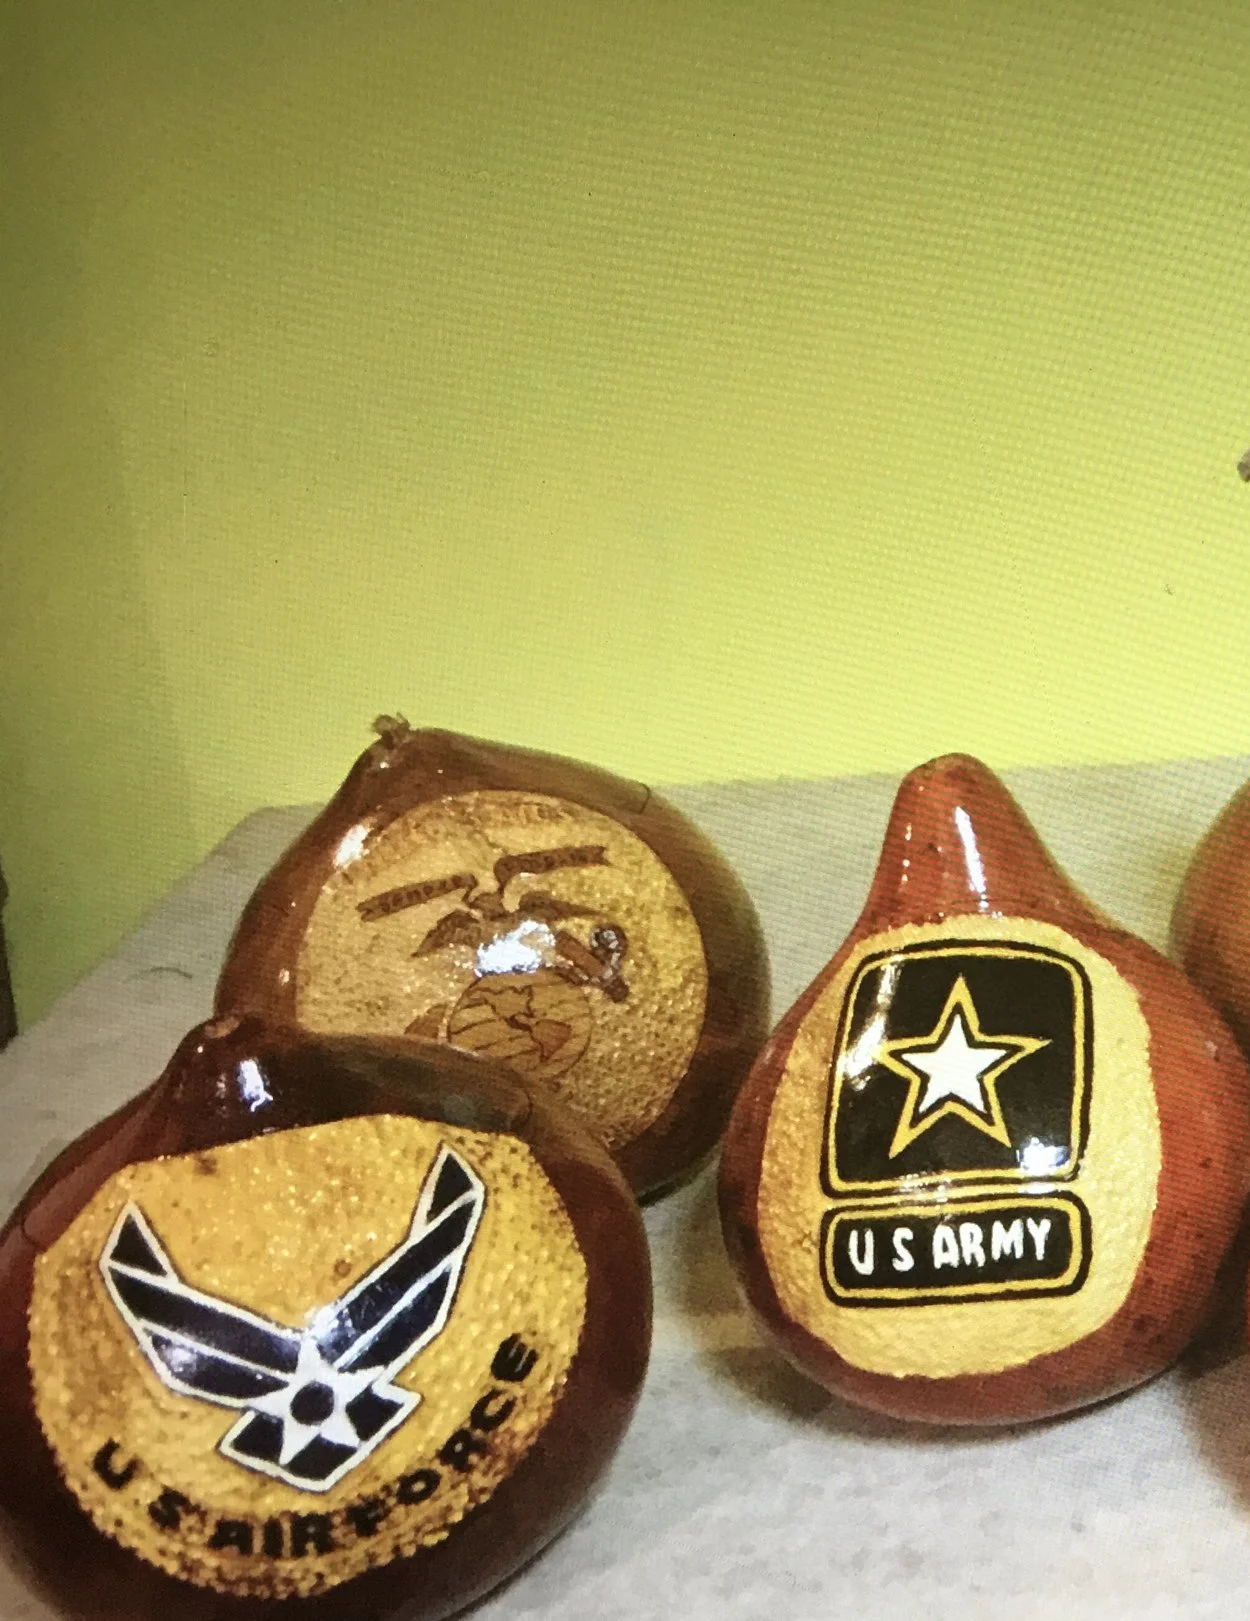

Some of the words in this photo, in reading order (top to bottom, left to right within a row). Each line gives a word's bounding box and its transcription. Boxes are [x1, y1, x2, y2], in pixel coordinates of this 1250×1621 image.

[848, 1229, 874, 1275] U
[892, 1227, 915, 1271] S
[932, 1217, 1052, 1269] ARMY
[207, 1511, 333, 1560] AIR
[345, 1332, 539, 1538] FORCE
